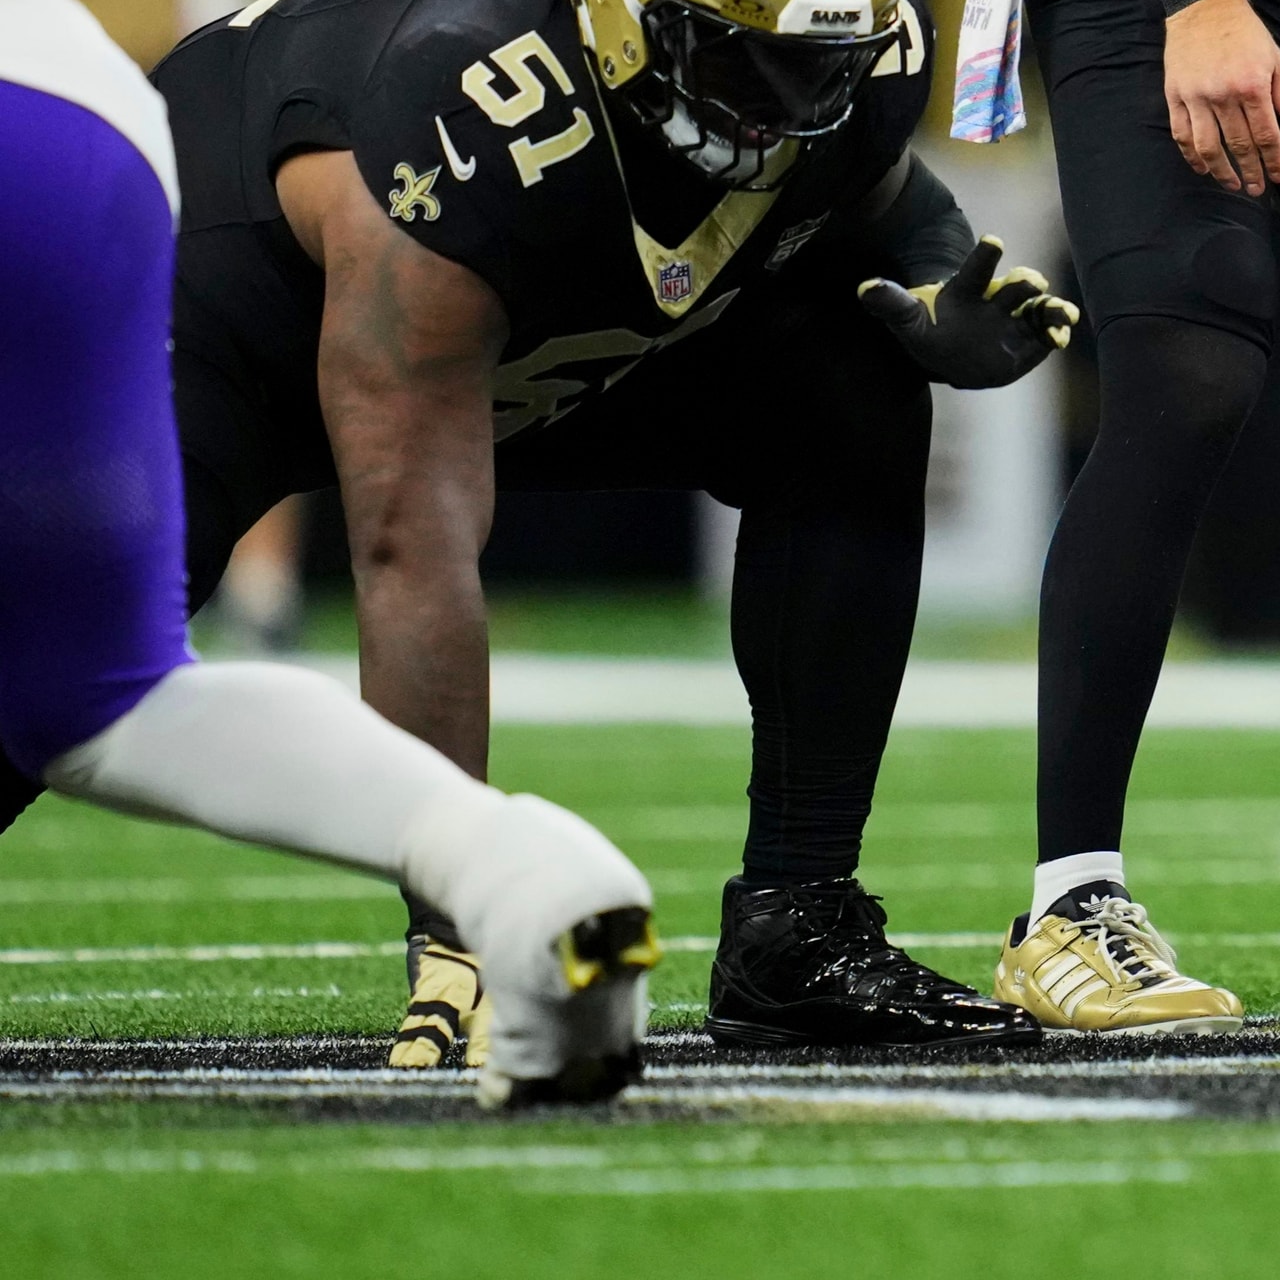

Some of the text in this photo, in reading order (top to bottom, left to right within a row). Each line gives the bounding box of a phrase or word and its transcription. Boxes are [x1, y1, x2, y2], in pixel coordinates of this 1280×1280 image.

[810, 10, 862, 25] SAINTS
[462, 30, 595, 188] 51
[663, 278, 688, 298] NFL
